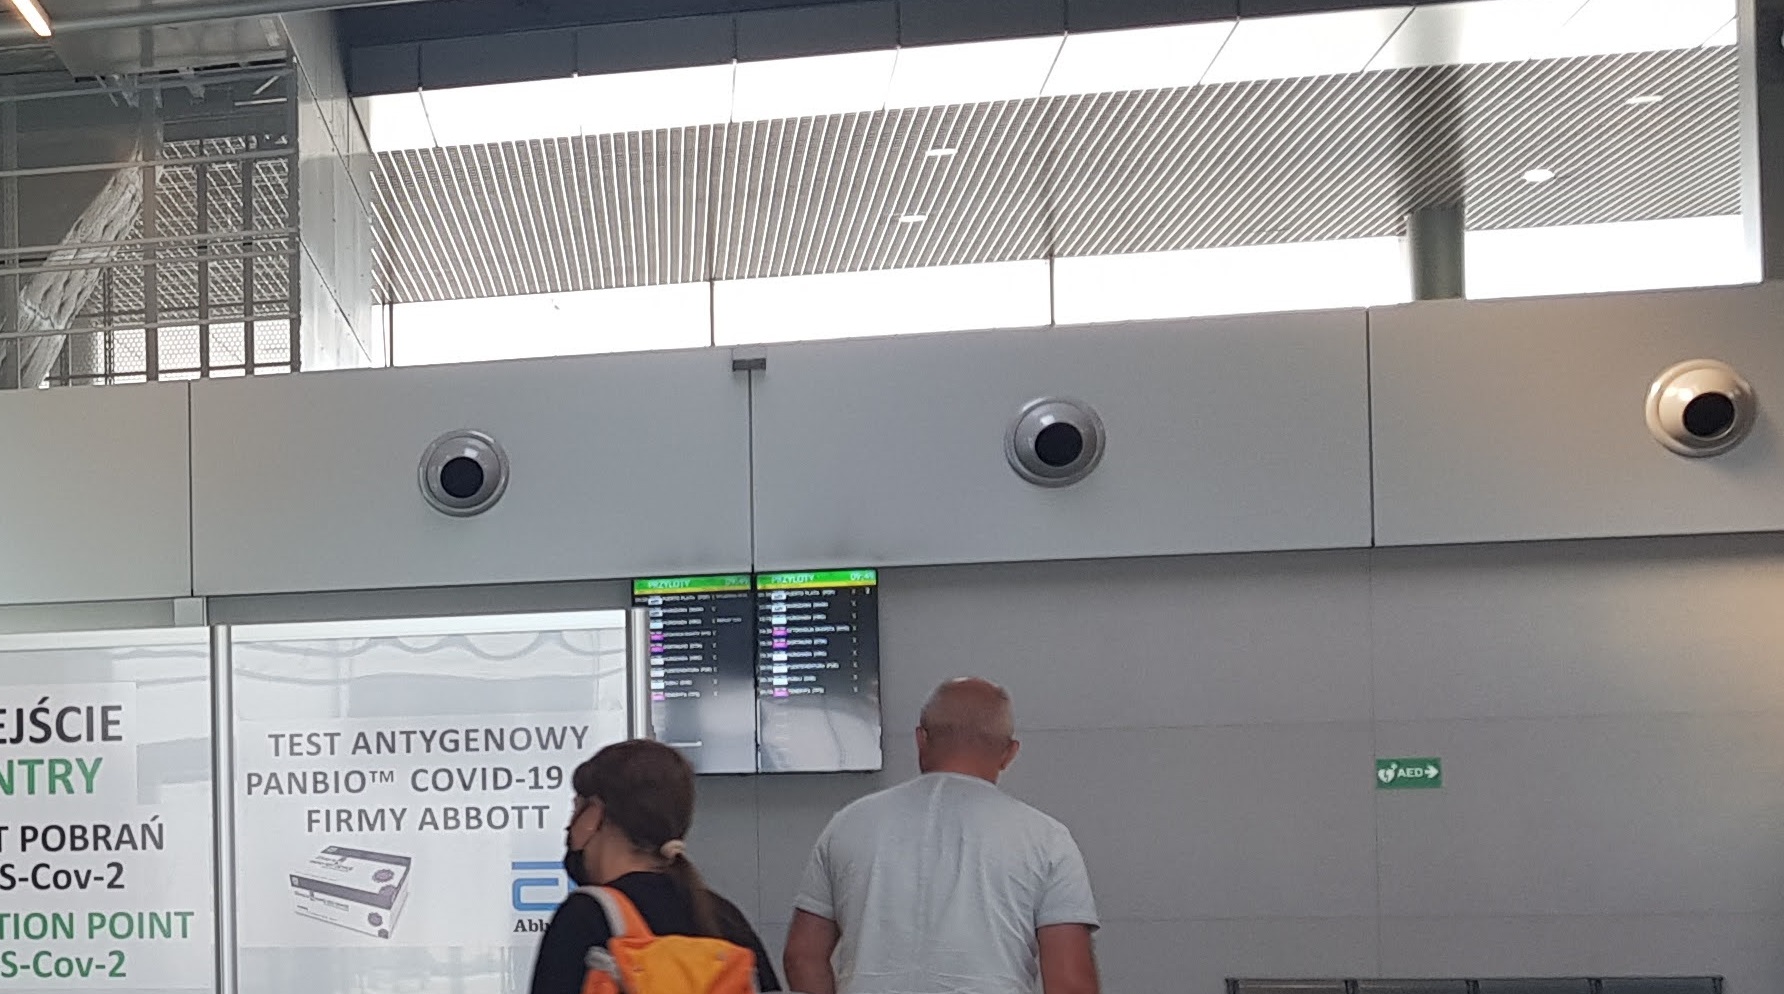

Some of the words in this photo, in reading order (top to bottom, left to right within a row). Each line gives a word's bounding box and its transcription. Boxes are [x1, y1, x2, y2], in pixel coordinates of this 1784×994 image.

[267, 731, 342, 757] TEST
[351, 725, 589, 756] ANTYGENOWY
[410, 765, 564, 793] COVID-19
[1397, 767, 1424, 778] AED
[307, 807, 408, 833] FIRMY
[417, 805, 550, 831] ABBOTT
[20, 814, 164, 853] POBRAŃ
[87, 911, 195, 940] POINT
